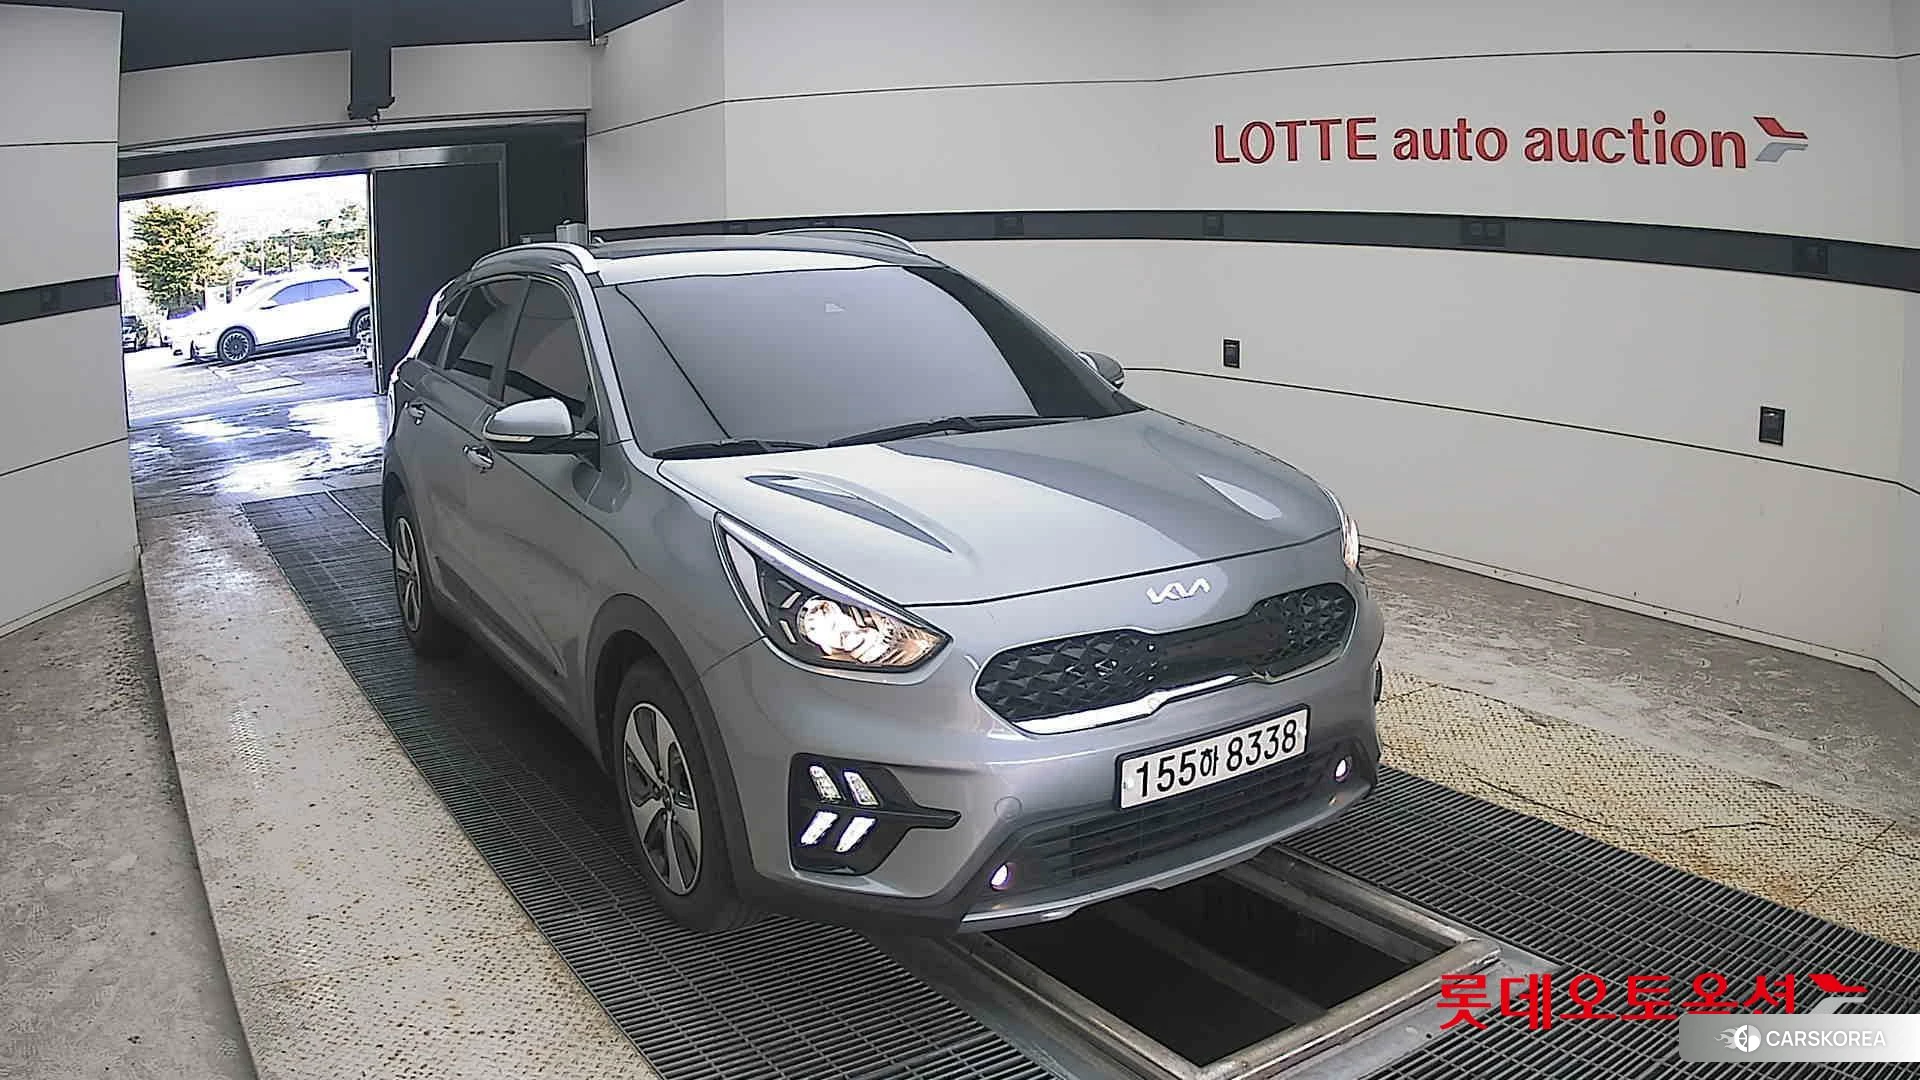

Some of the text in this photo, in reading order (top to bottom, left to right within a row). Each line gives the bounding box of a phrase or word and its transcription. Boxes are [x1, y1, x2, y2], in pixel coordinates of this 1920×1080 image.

[1214, 109, 1748, 169] LOTTE auto auction
[1146, 577, 1211, 605] KIA
[1136, 718, 1298, 798] 155하 8338
